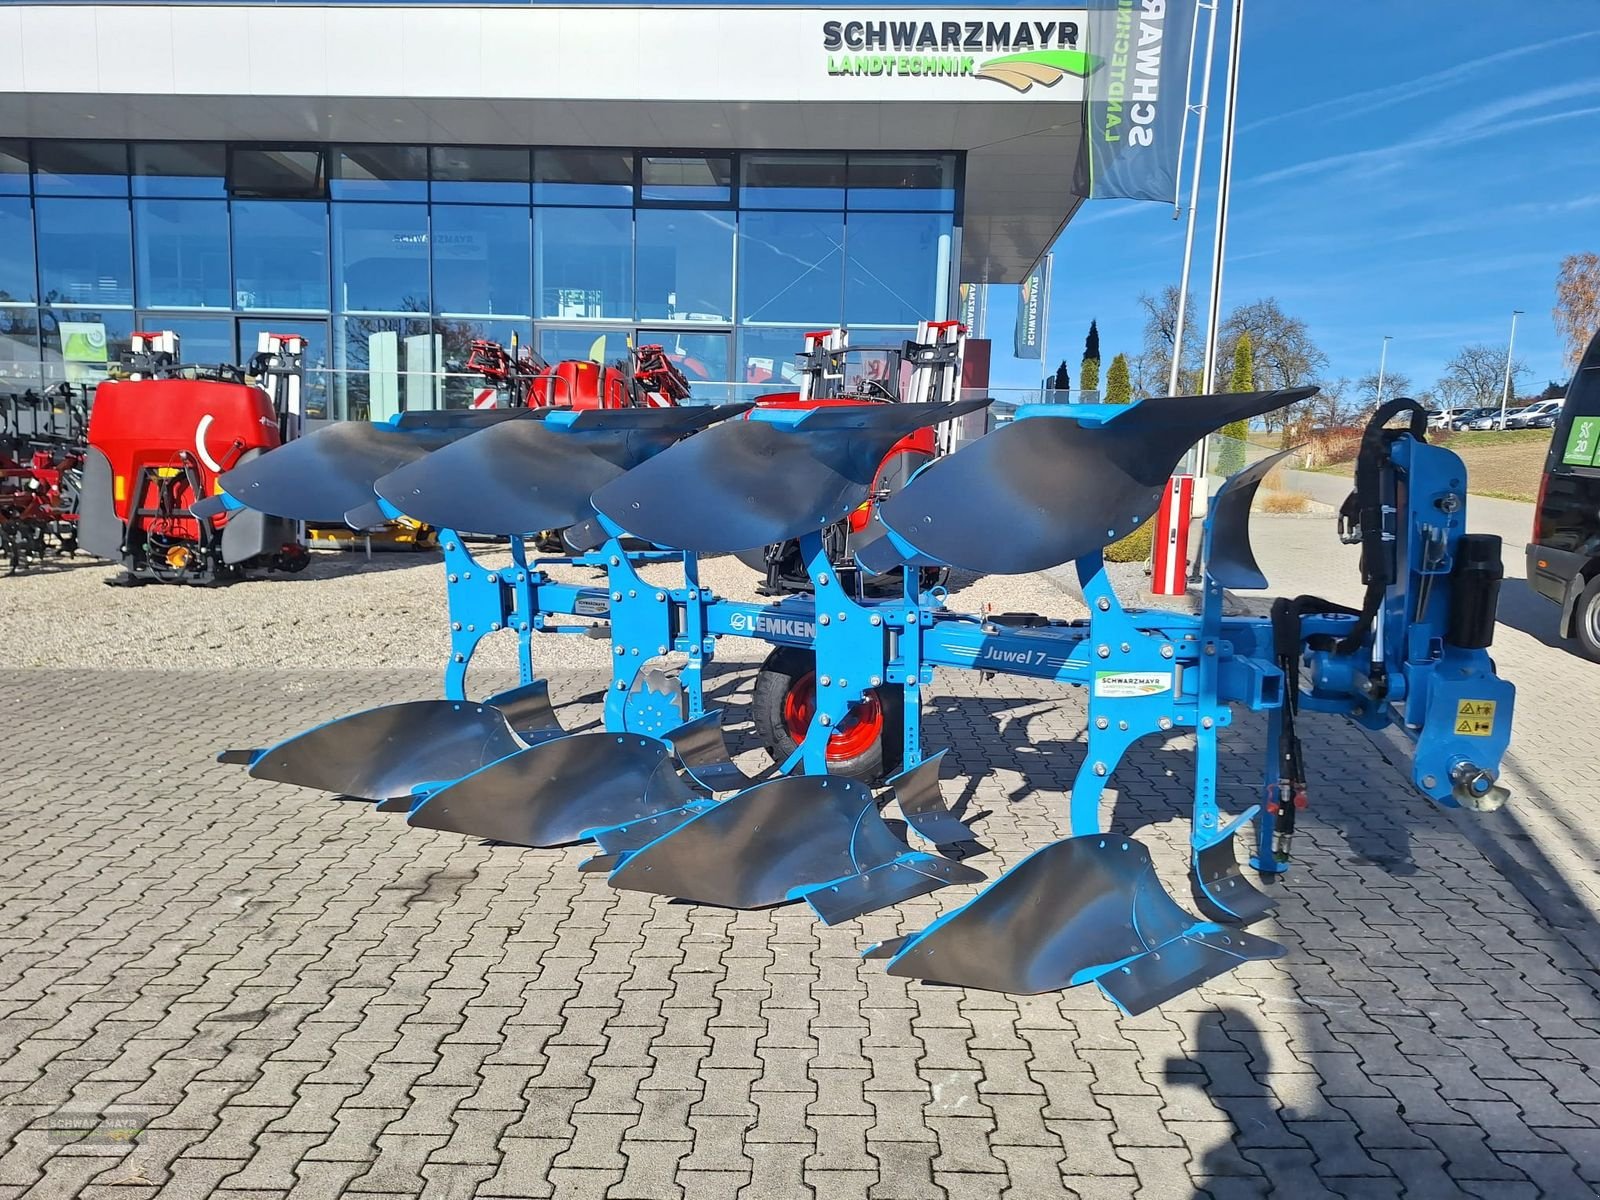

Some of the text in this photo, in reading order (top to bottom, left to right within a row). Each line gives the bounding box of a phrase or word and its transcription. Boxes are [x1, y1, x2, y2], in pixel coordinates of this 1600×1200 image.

[823, 21, 1079, 49] SCHWARZMAYR
[828, 55, 975, 76] LANDTECHNIK
[1574, 440, 1588, 452] 20
[747, 615, 816, 638] LEMKEN
[984, 646, 1047, 665] Juwel 7
[1102, 677, 1160, 685] SCHWARZMAYR
